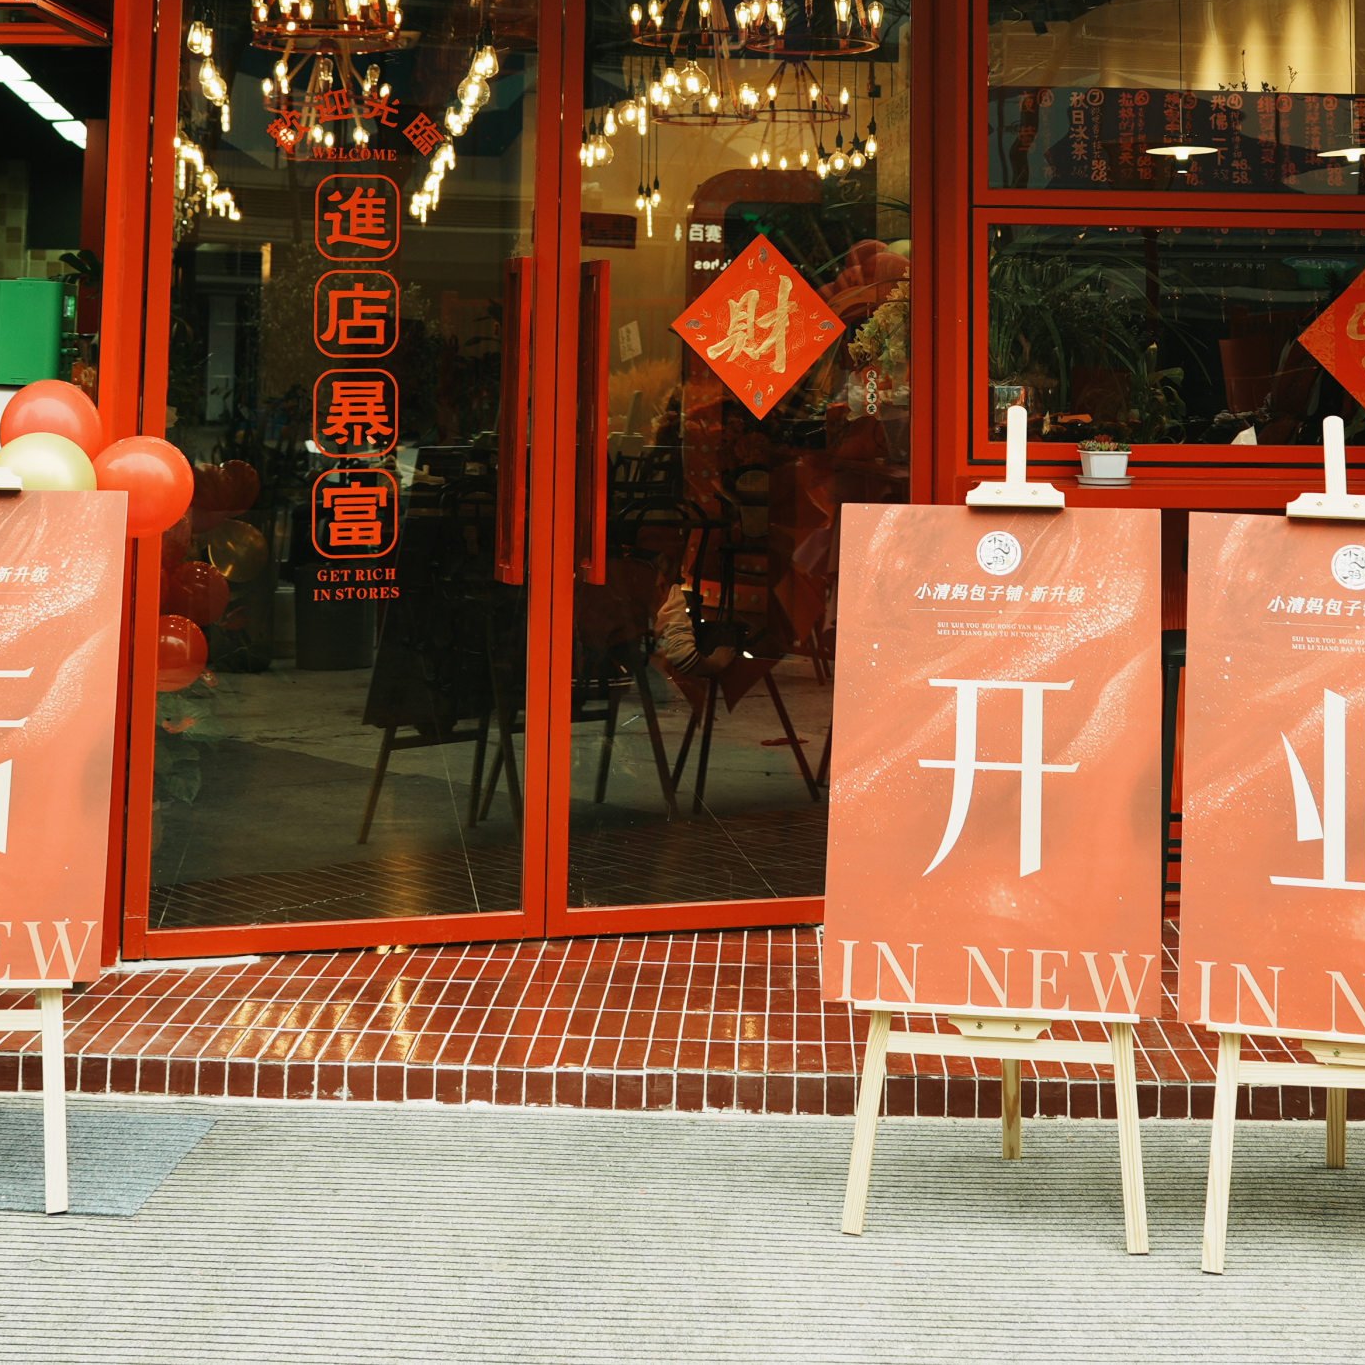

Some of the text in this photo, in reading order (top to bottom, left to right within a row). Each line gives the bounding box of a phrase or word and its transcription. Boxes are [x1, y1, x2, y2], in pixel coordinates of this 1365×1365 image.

[311, 146, 397, 162] WELCOME
[320, 186, 393, 547] 進店暴富
[313, 587, 400, 602] IN STORES
[317, 568, 396, 582] GET RICH
[917, 678, 1081, 878] 开
[837, 940, 1156, 1015] IN NEW
[1194, 960, 1285, 1031] IN
